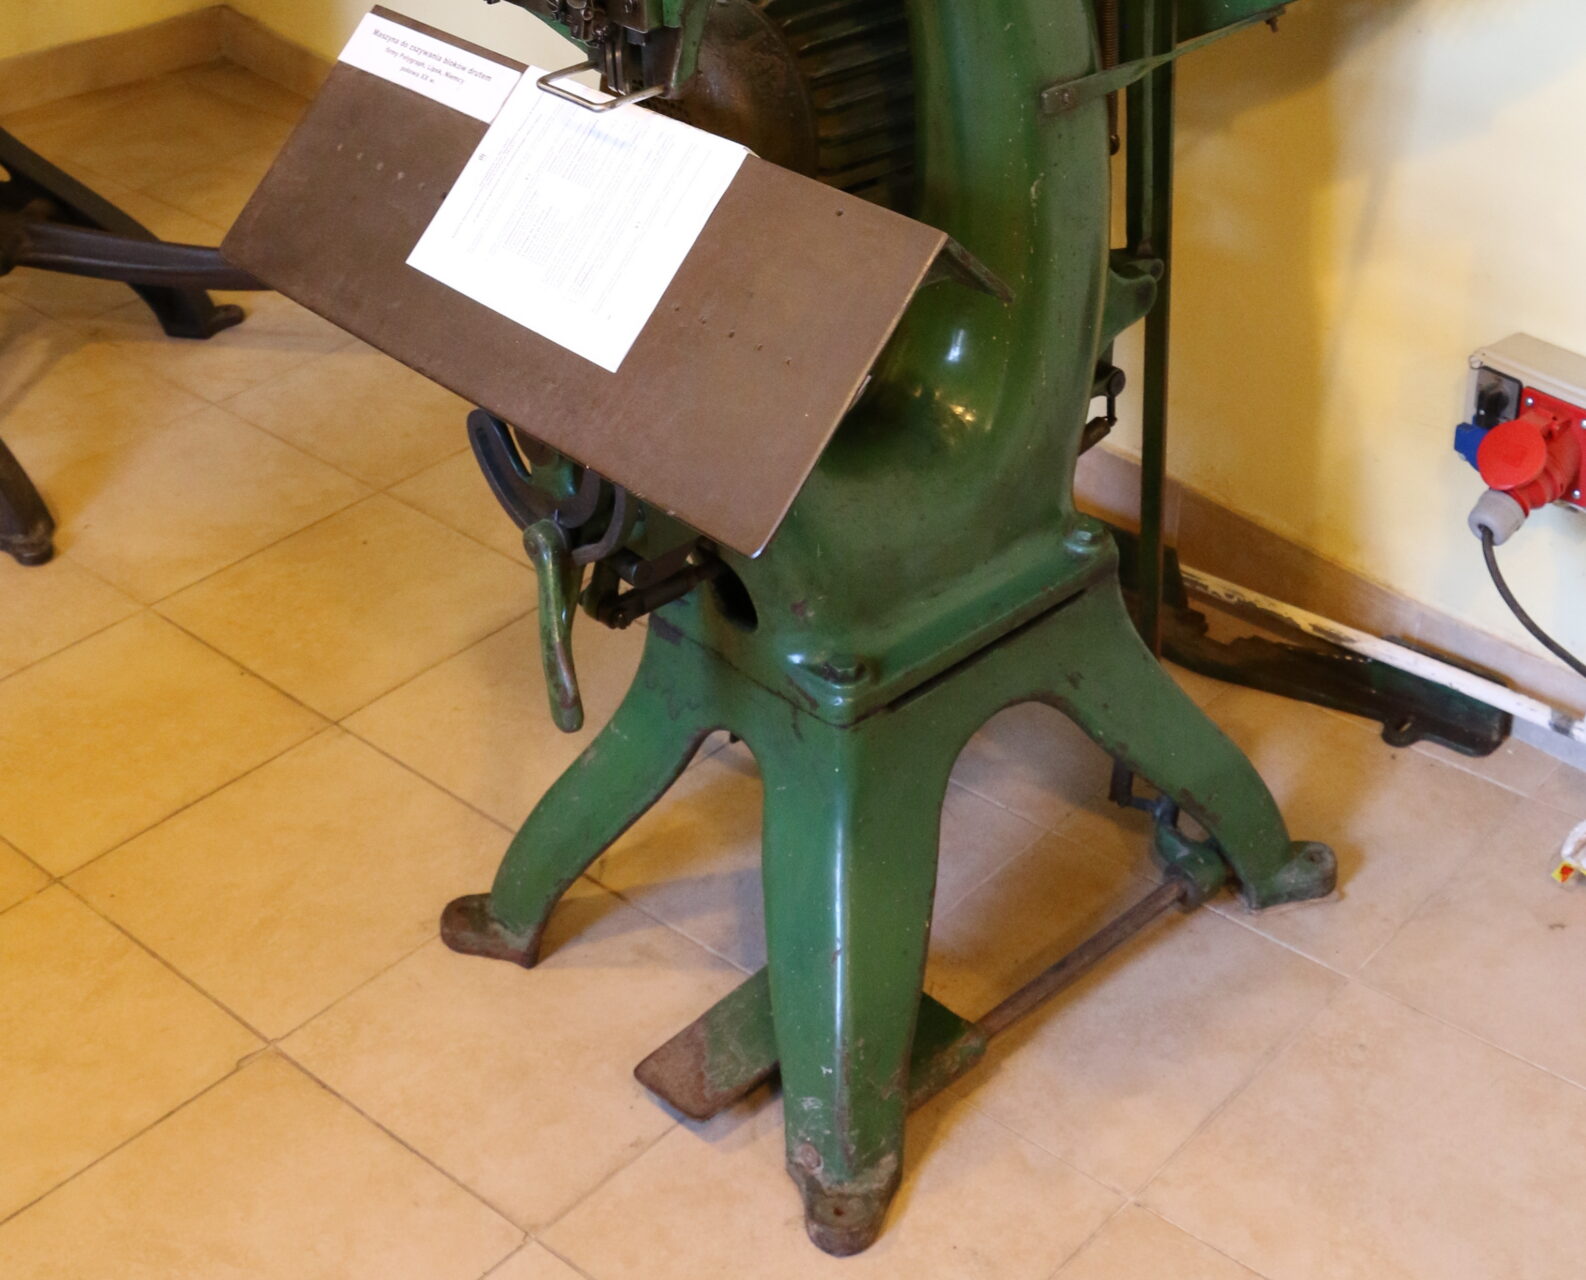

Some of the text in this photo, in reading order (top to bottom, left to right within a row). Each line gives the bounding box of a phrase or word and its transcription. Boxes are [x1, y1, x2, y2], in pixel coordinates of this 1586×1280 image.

[373, 29, 400, 44] Maszyna
[400, 40, 409, 48] do
[409, 44, 442, 62] zszywania
[467, 67, 492, 81] drutem
